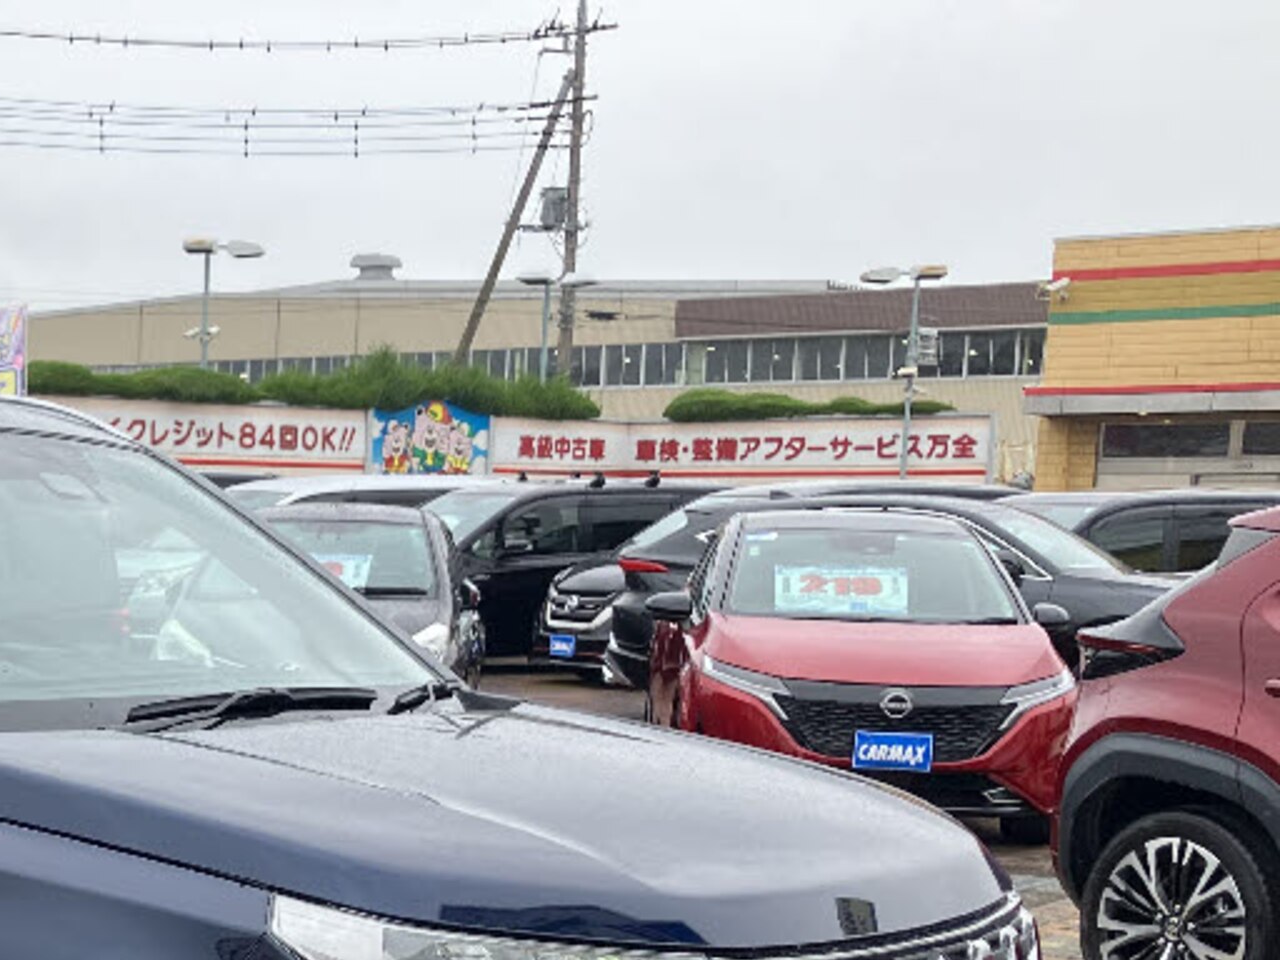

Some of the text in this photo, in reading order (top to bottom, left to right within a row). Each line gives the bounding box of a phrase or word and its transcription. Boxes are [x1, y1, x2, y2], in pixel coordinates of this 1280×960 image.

[110, 416, 357, 452] クレジット84回OK!!
[858, 742, 928, 766] CARMAX
